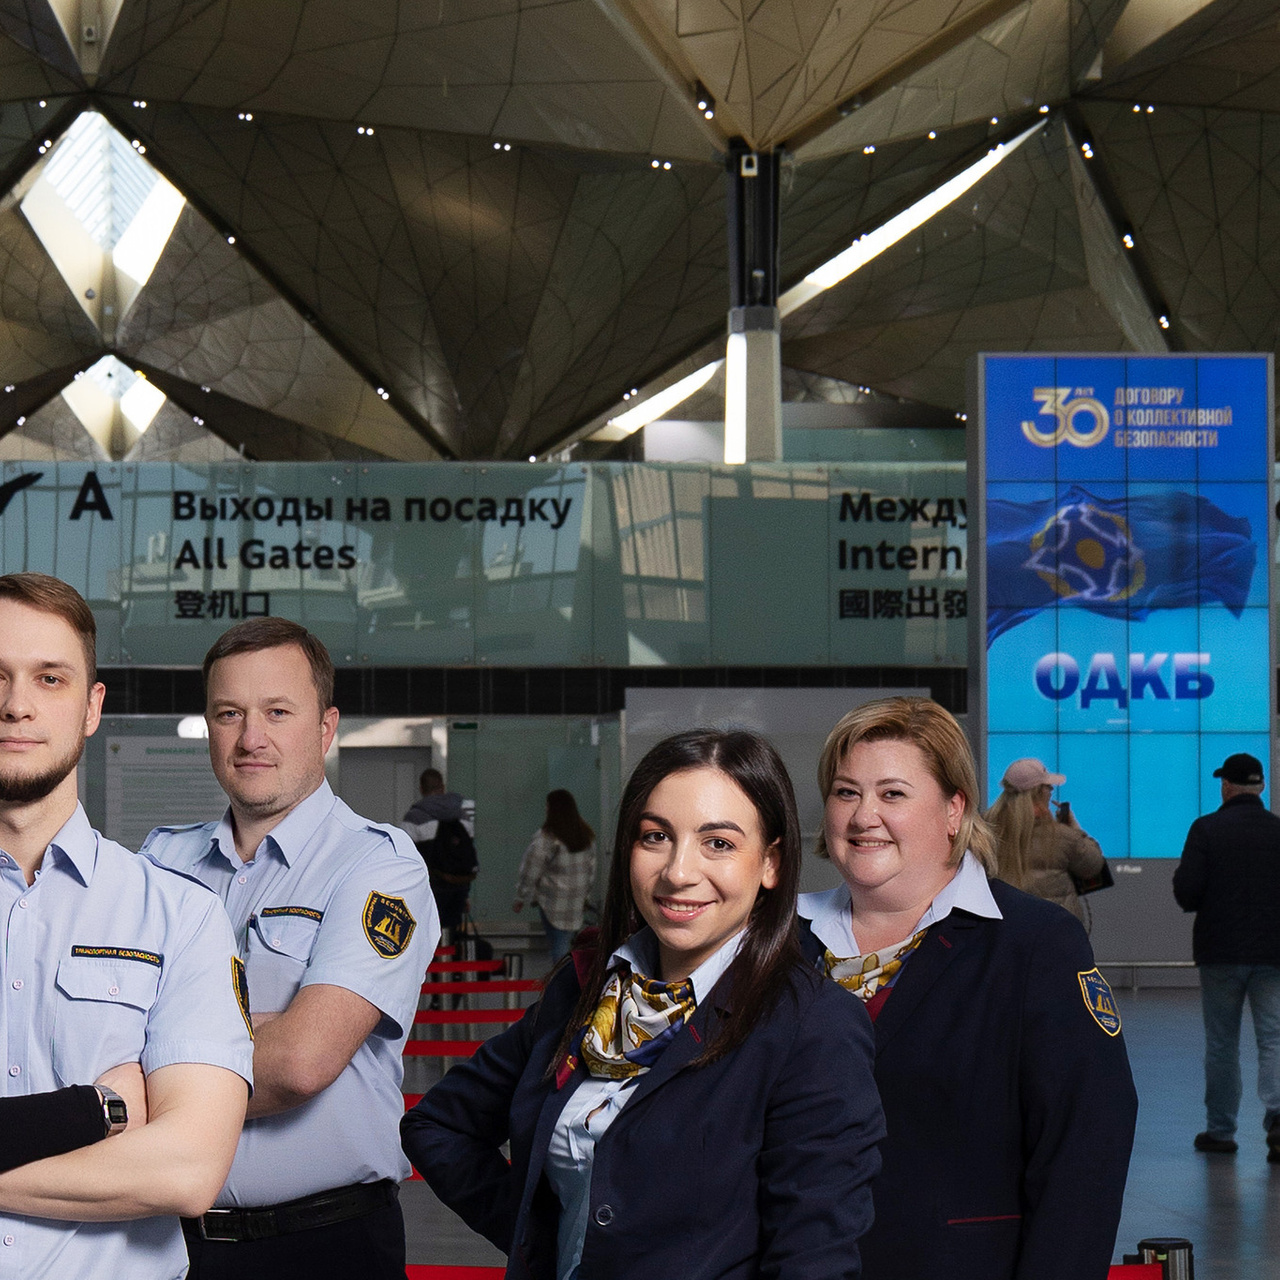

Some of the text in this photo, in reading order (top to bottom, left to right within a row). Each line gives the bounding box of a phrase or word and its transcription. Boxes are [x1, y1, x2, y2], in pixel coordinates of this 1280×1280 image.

[1114, 387, 1185, 405] ДОГОВОРУ
[1021, 386, 1109, 448] 30
[1127, 405, 1233, 426] КОЛЛЕКТИВНОЙ
[1114, 430, 1219, 448] БЕЗОПАСНОСТИ
[173, 491, 573, 530] Выходы на посадку
[174, 537, 357, 571] All Gates
[174, 589, 270, 619] 登机口
[1034, 652, 1215, 710] ОДКБ
